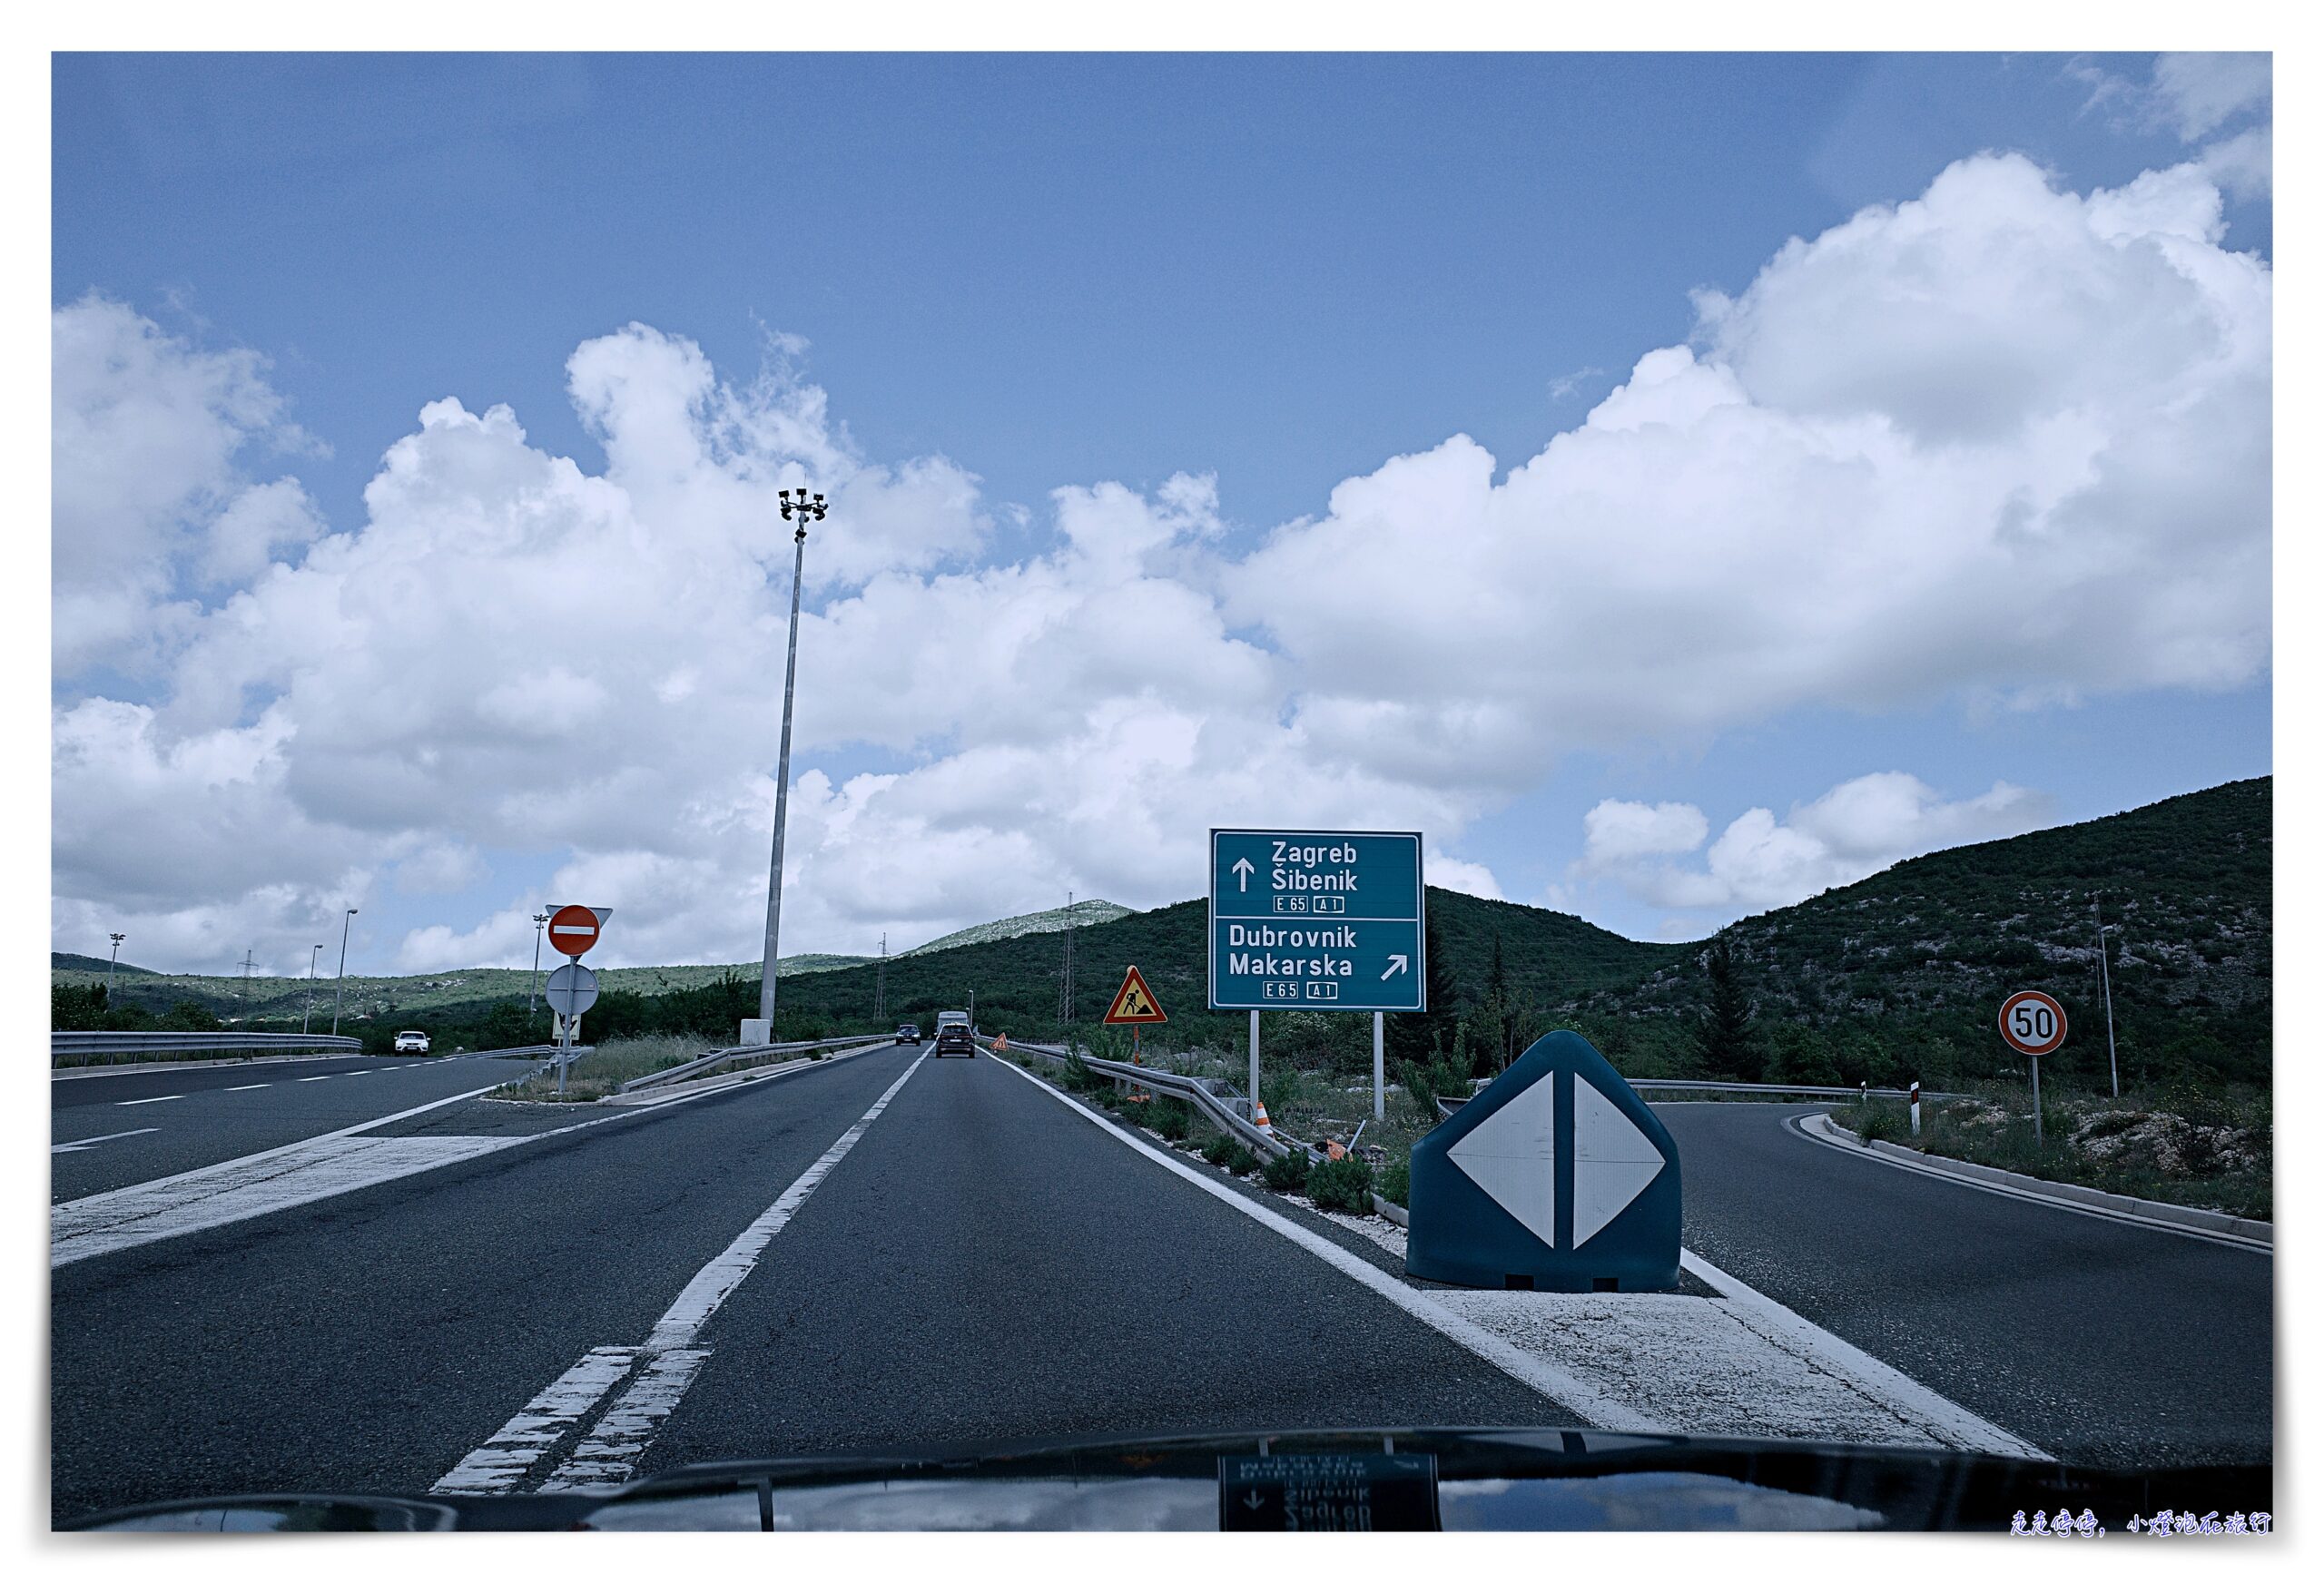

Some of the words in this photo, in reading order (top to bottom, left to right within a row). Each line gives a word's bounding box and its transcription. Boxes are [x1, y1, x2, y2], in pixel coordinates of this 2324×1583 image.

[1272, 841, 1357, 869] Zagreb
[1272, 862, 1358, 891] Šibenik
[1276, 897, 1284, 911] E
[1290, 897, 1305, 911] 65
[1320, 898, 1327, 910] A
[1229, 924, 1358, 948] Dubrovnik
[1229, 952, 1353, 976] Makarska
[1266, 983, 1274, 997] E
[1278, 983, 1296, 997] 65
[1313, 984, 1321, 997] A
[2015, 1007, 2053, 1039] 50
